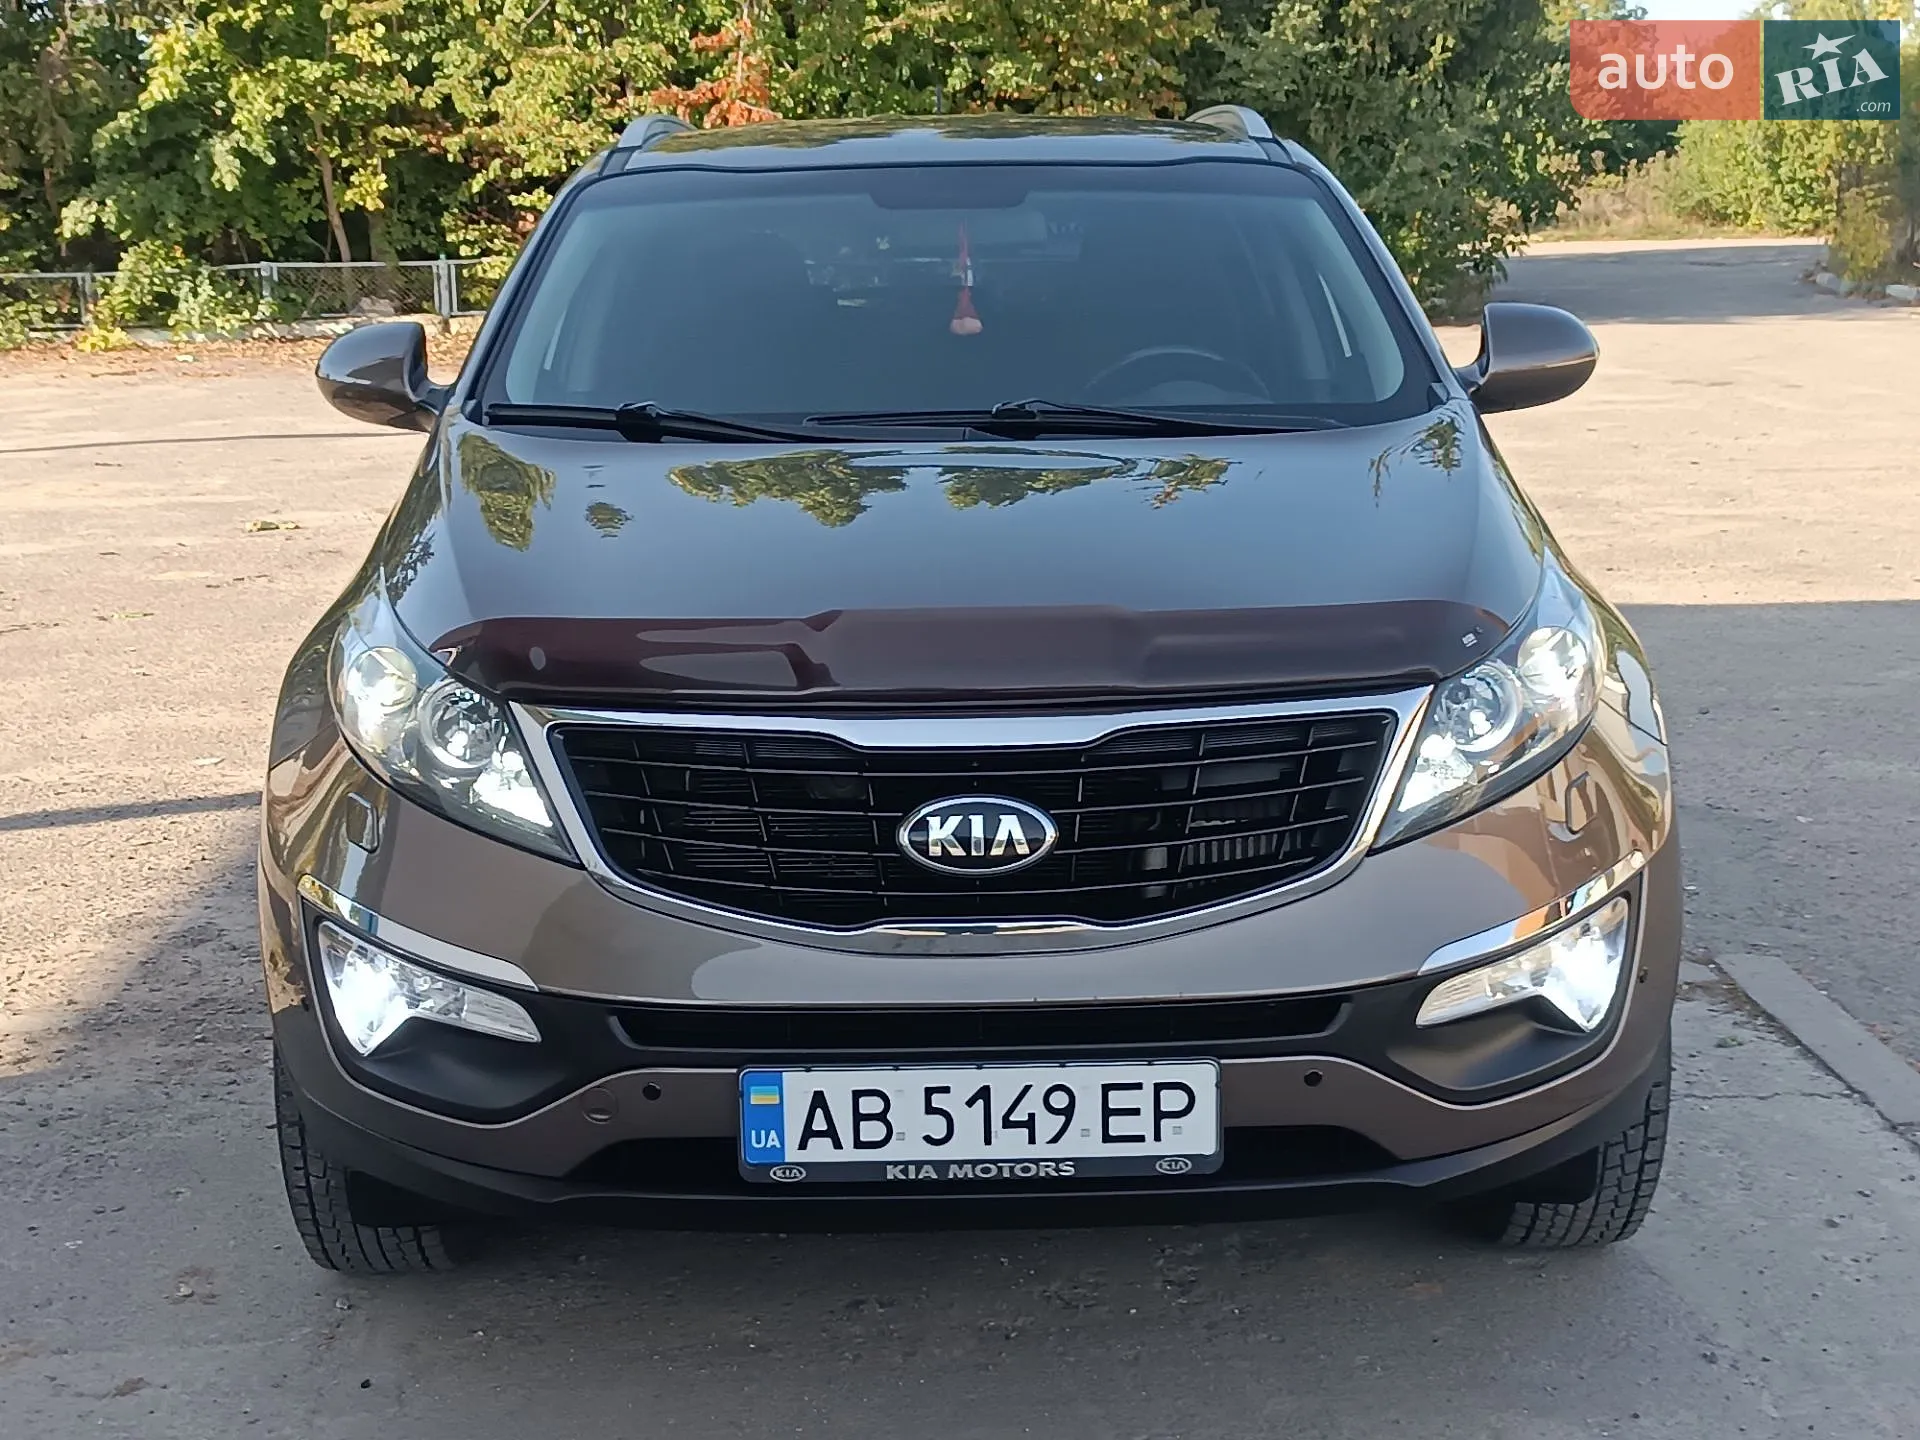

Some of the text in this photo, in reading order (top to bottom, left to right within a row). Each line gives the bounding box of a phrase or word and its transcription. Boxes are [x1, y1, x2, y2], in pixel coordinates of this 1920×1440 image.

[926, 814, 1031, 857] KIA
[797, 1081, 1196, 1151] AB 5149 EP
[751, 1129, 781, 1149] UA
[775, 1168, 801, 1178] KIA
[886, 1161, 1076, 1180] KIA MOTORS
[1161, 1161, 1187, 1171] KIA
